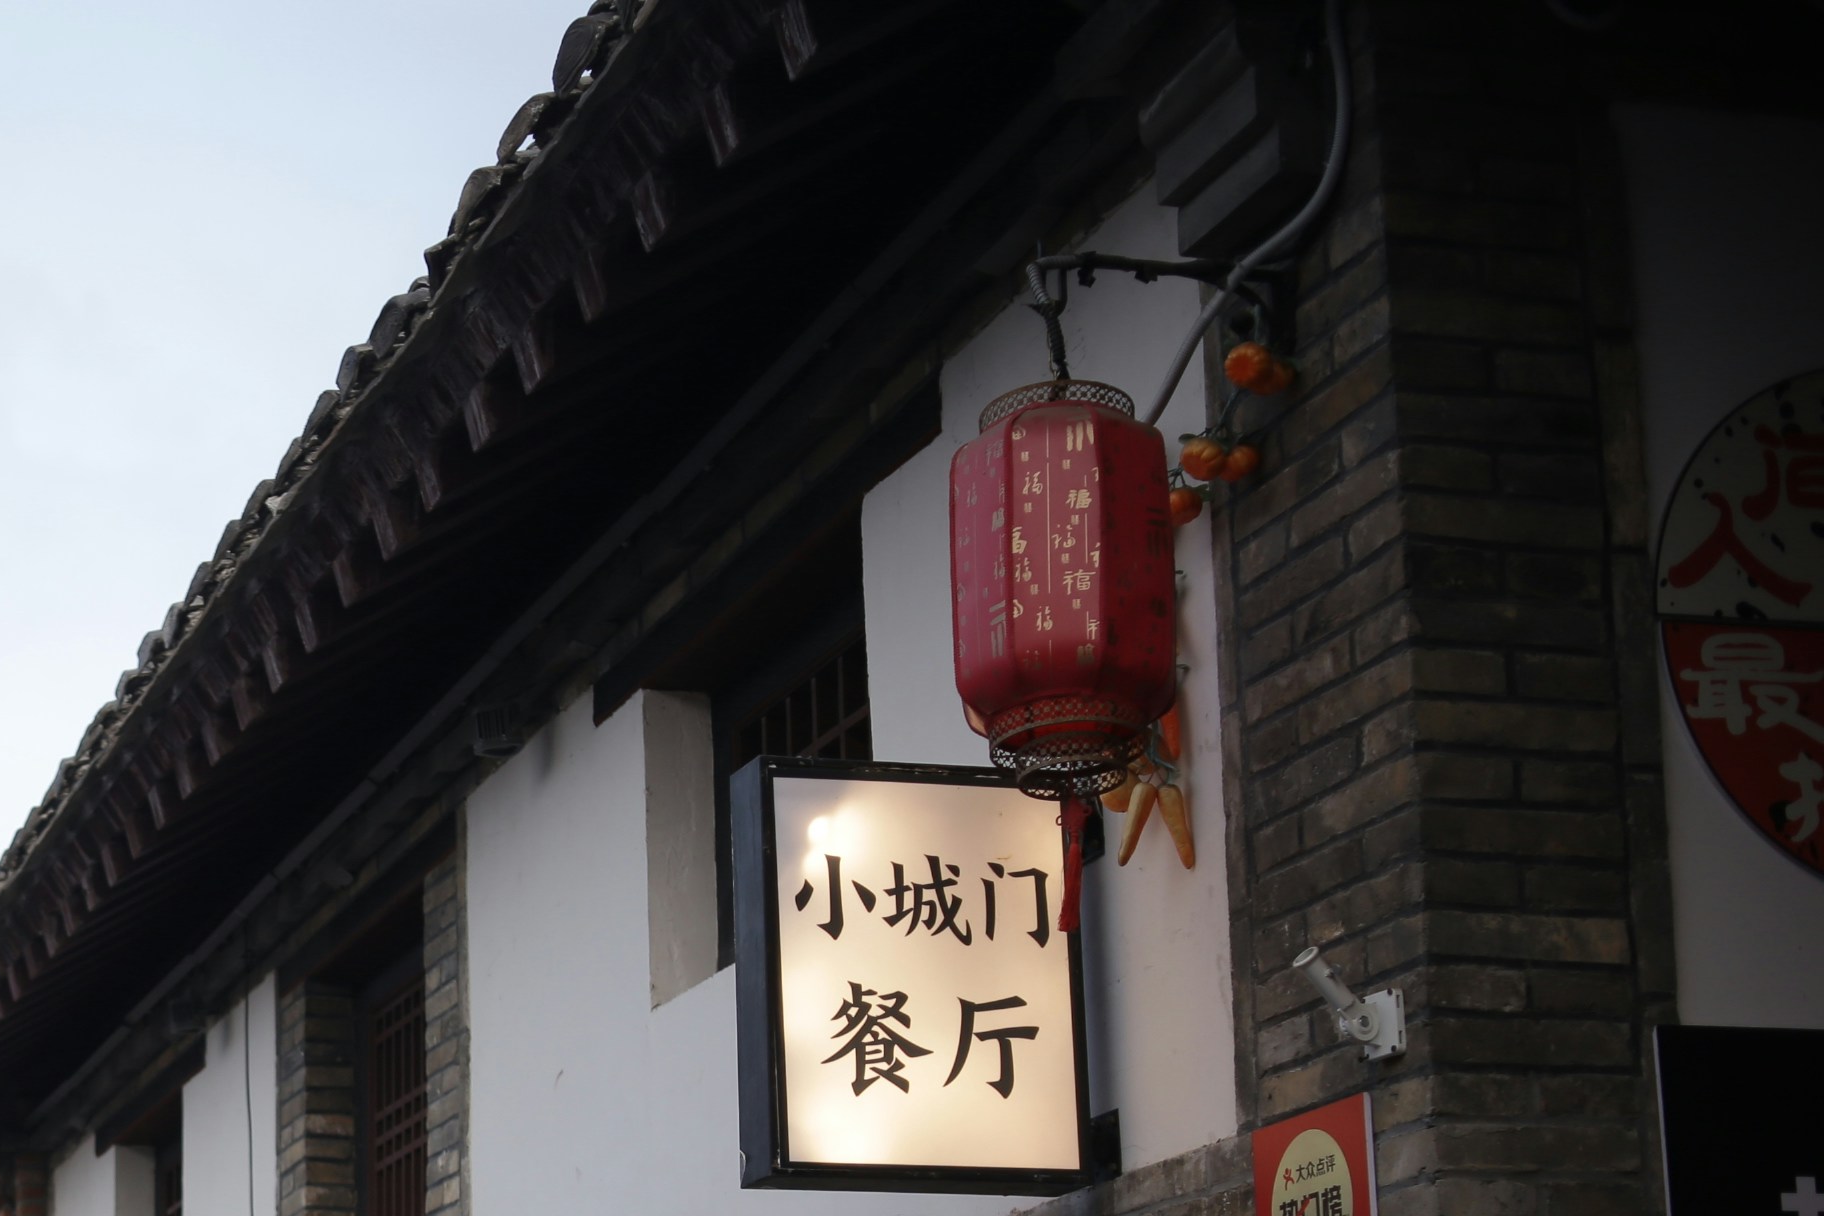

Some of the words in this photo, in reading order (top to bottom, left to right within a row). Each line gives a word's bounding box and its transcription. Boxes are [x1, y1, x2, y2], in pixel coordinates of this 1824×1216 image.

[795, 853, 1051, 950] 小城门
[821, 981, 1041, 1100] 餐厅
[1295, 1154, 1337, 1183] 大众点评
